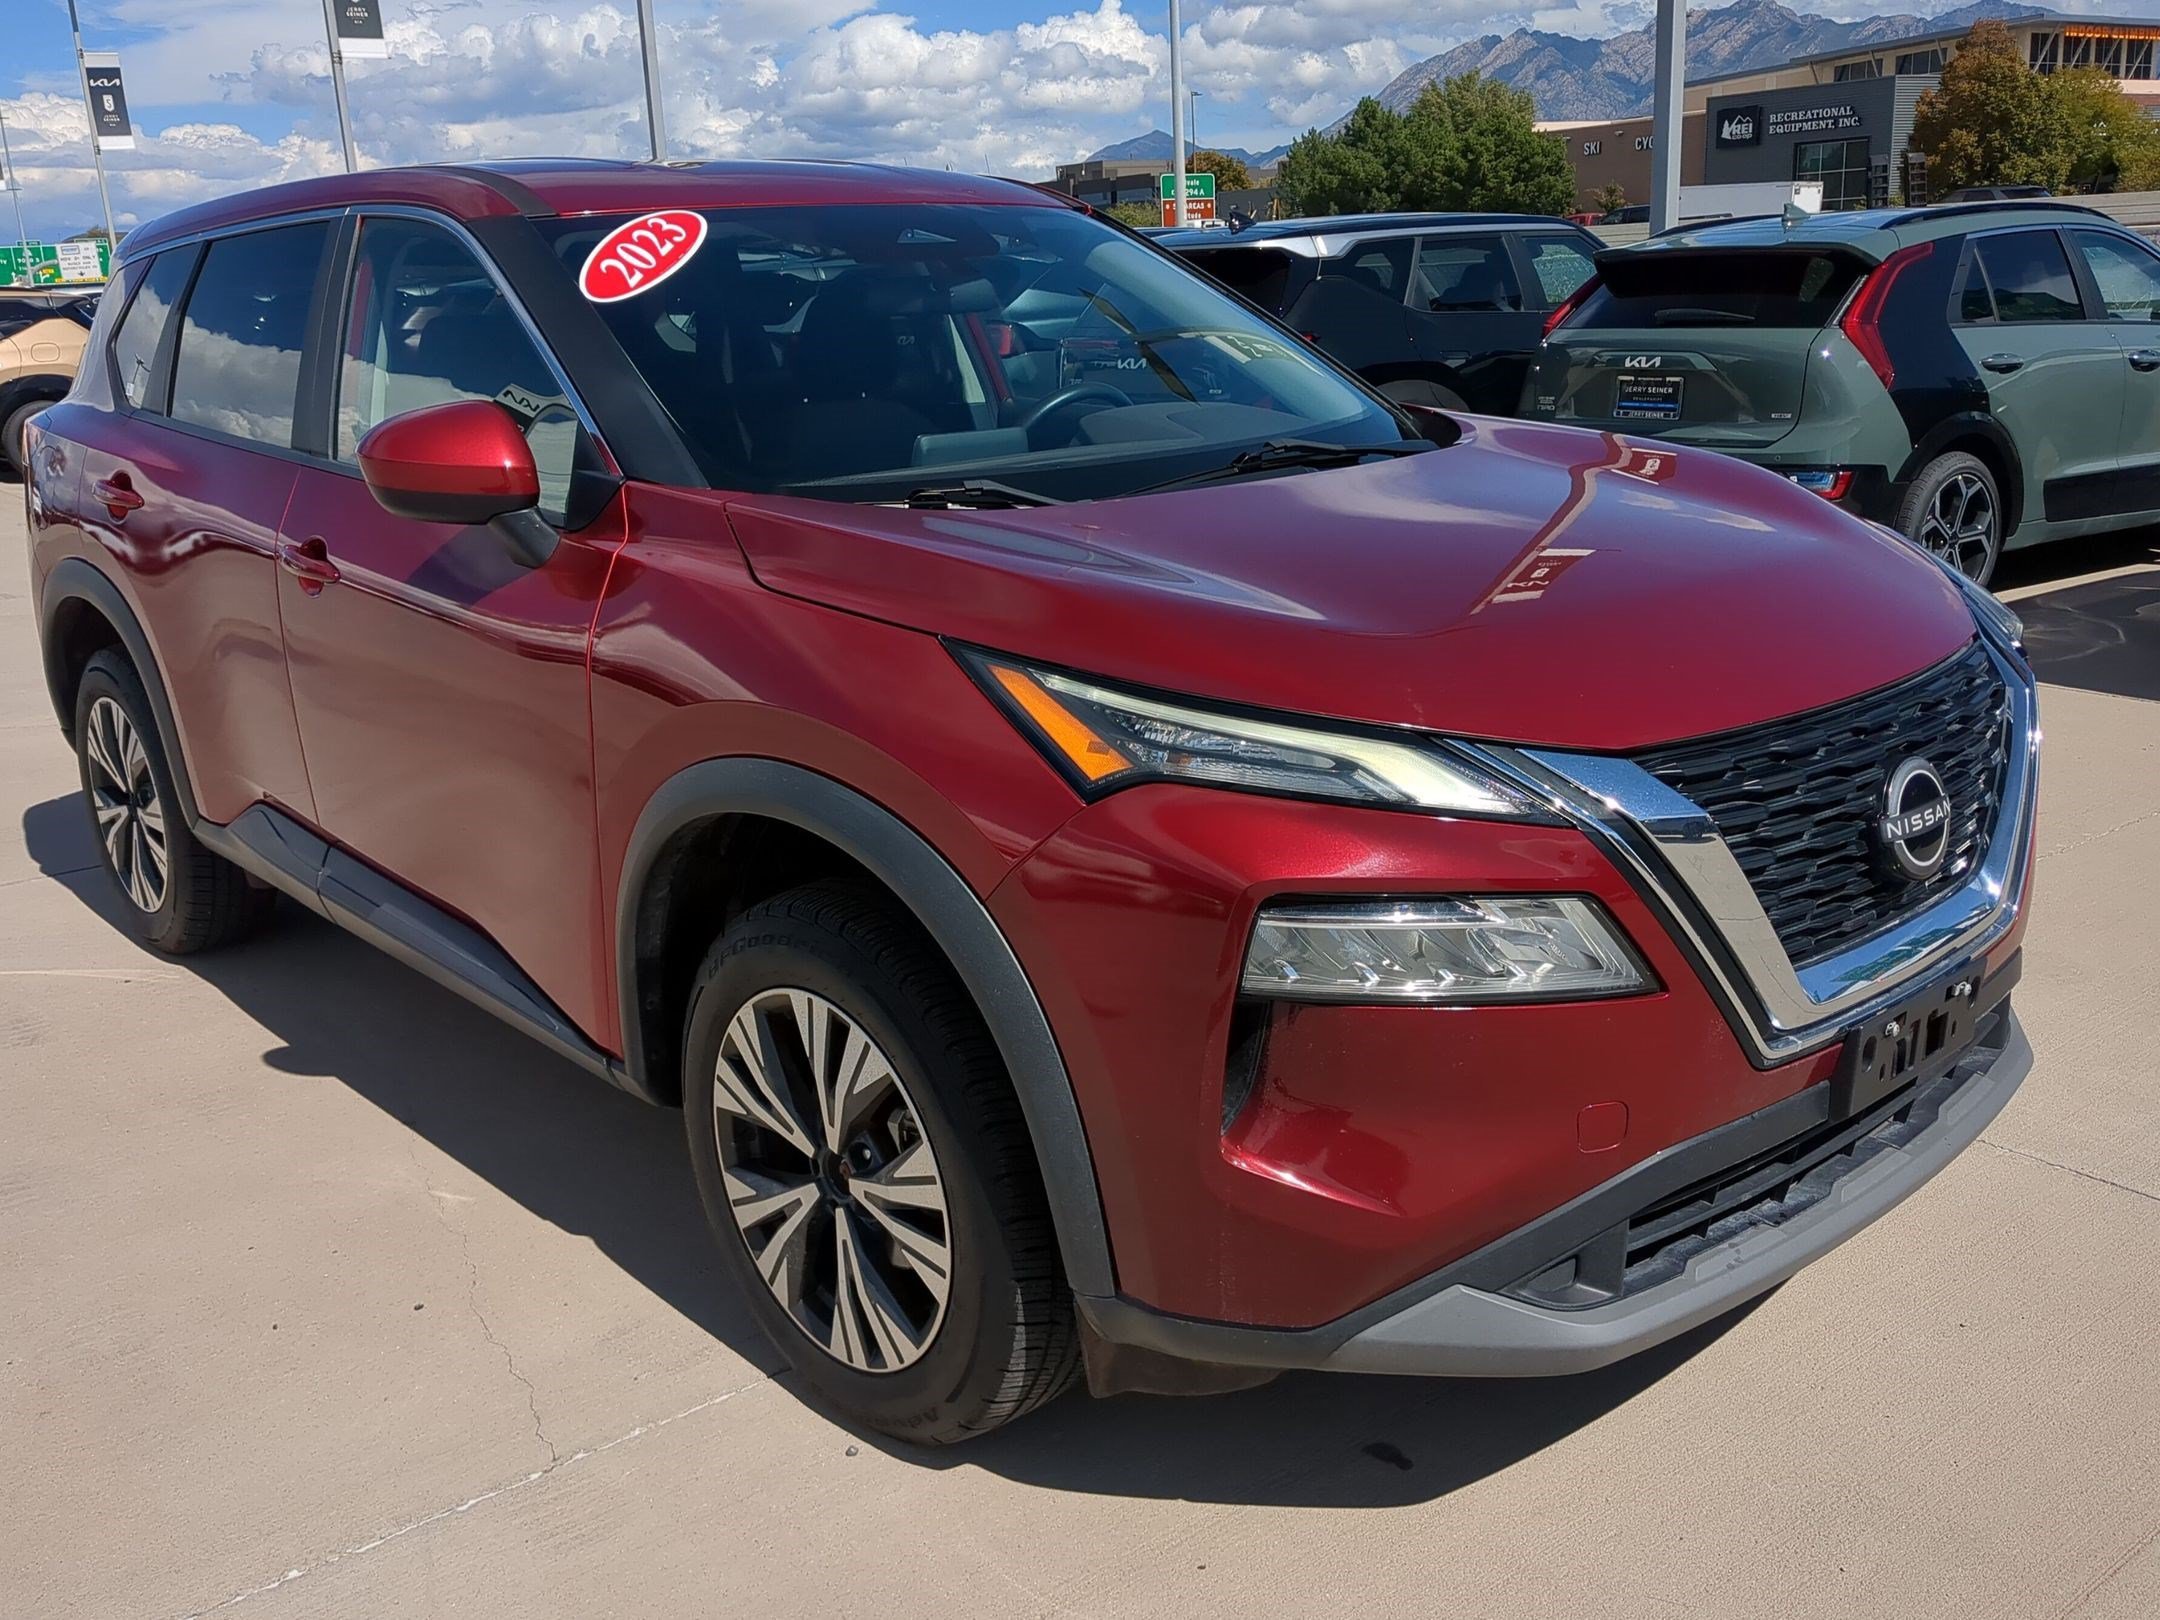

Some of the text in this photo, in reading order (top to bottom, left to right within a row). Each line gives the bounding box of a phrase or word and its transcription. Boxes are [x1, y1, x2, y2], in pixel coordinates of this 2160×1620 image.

[89, 78, 120, 87] KIA
[1769, 105, 1853, 123] RECREATIONAL
[1731, 122, 1753, 135] REI
[1768, 116, 1860, 134] EQUIPMENT, INC.
[1583, 141, 1600, 156] SKI
[600, 217, 687, 288] 2023
[1117, 357, 1147, 369] KIA
[1625, 356, 1661, 368] KIA
[1886, 800, 1951, 839] NISSAN
